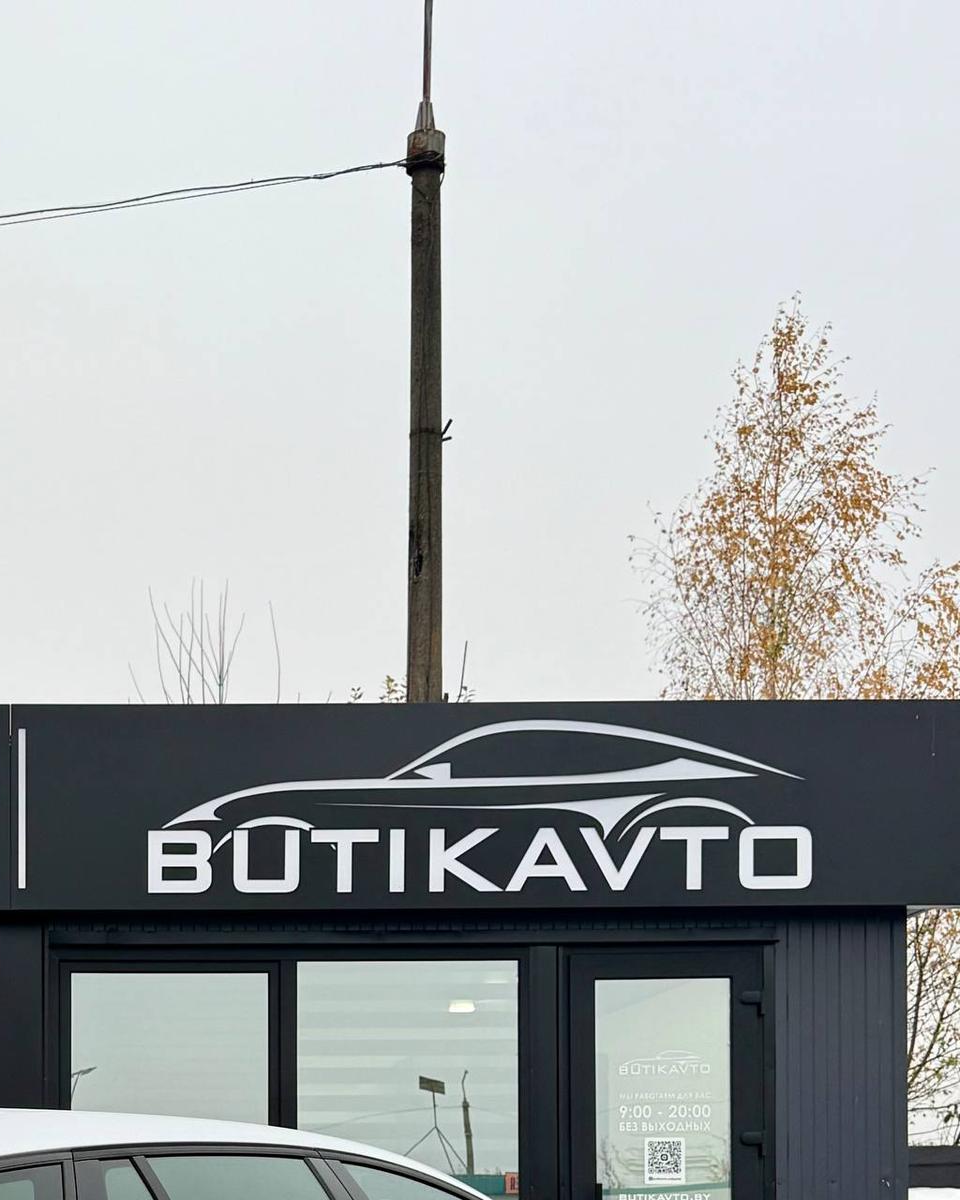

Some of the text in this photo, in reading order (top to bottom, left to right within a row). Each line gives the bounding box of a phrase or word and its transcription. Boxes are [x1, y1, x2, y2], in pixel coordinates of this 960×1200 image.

[147, 825, 812, 893] BUTIKAVTO
[619, 1064, 711, 1075] BUTIKAVTO
[619, 1105, 651, 1118] 9:00
[668, 1104, 711, 1118] 20:00
[619, 1120, 711, 1132] БЕЗ ВЫХОДНЫХ
